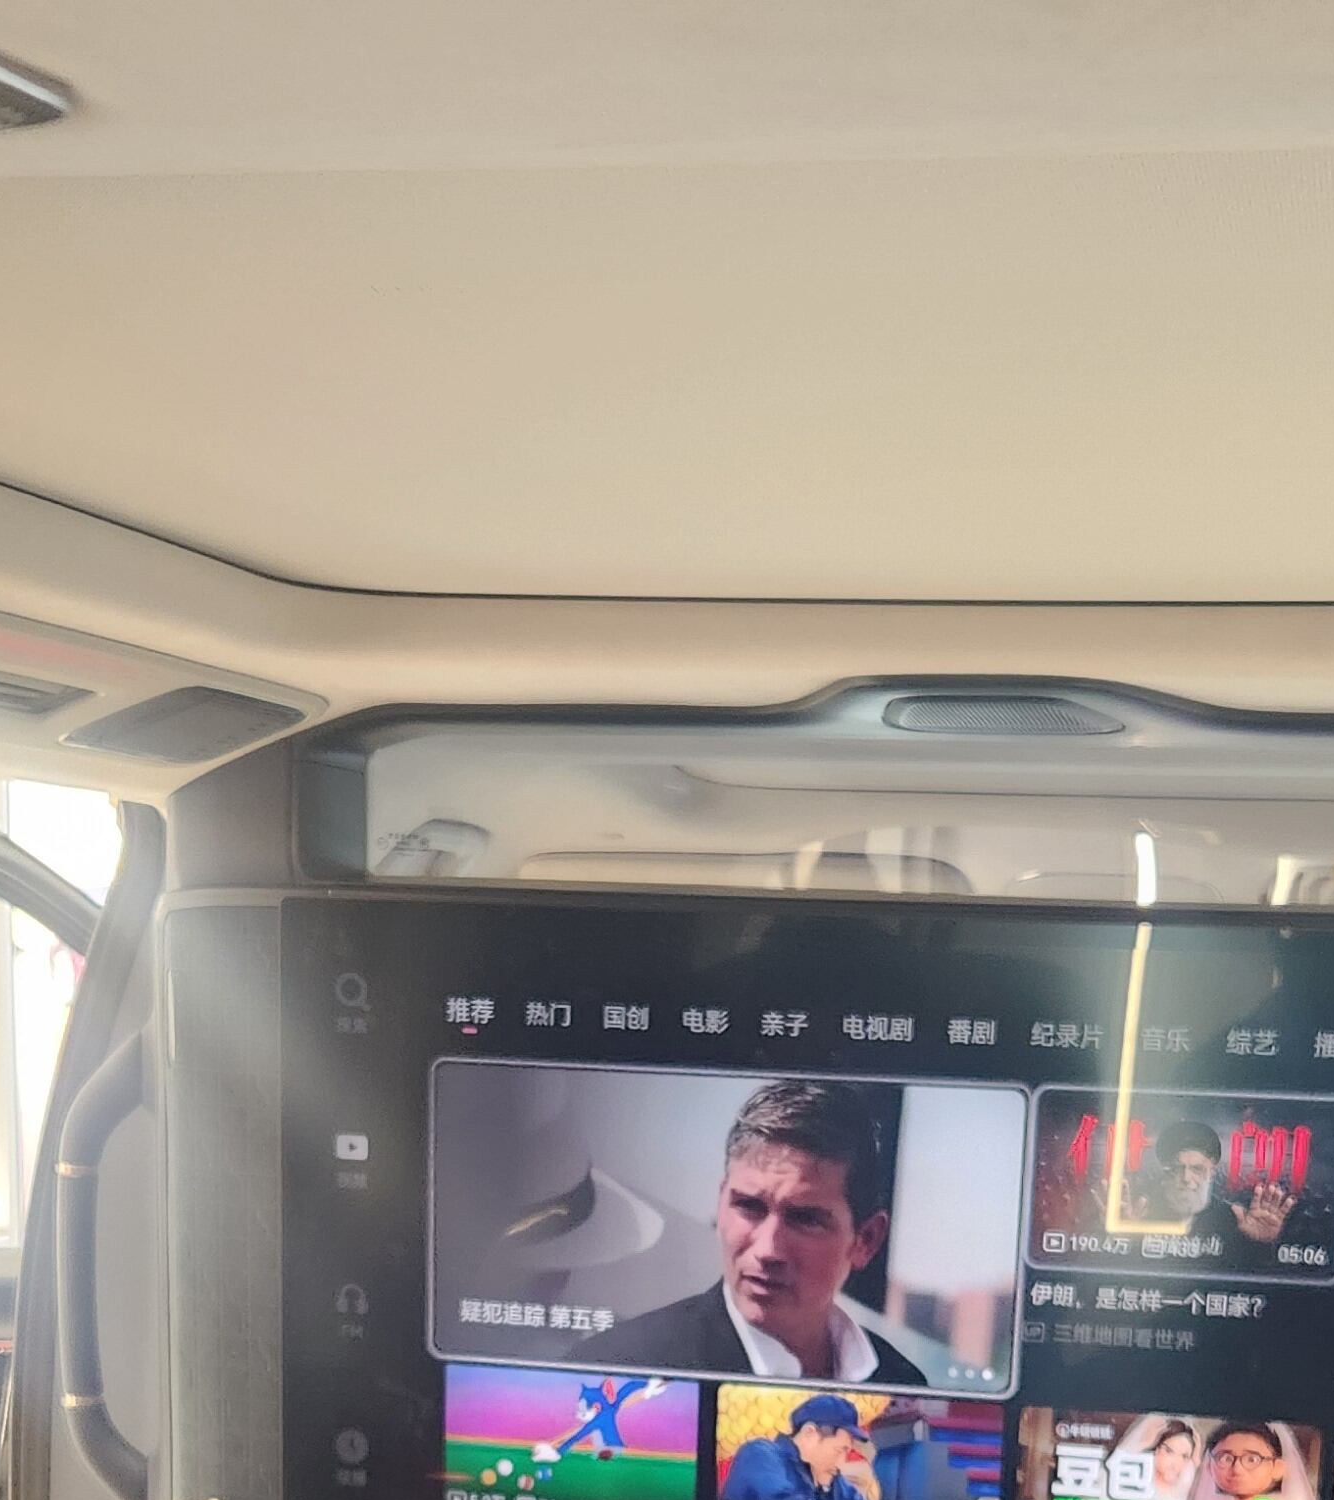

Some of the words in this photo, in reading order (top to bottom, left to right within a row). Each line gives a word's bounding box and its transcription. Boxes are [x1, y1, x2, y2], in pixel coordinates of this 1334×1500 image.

[446, 997, 495, 1025] 推荐
[525, 1003, 572, 1028] 热门
[603, 1005, 650, 1031] 国创
[682, 1008, 730, 1034] 电影
[760, 1011, 808, 1037] 亲子
[842, 1015, 914, 1042] 电视剧
[948, 1019, 995, 1046] 番剧
[1030, 1022, 1103, 1050] 纪录片
[1141, 1028, 1190, 1052] 音乐
[1226, 1028, 1279, 1056] 综艺
[459, 1299, 545, 1328] 疑犯追踪
[549, 1304, 614, 1332] 第五季
